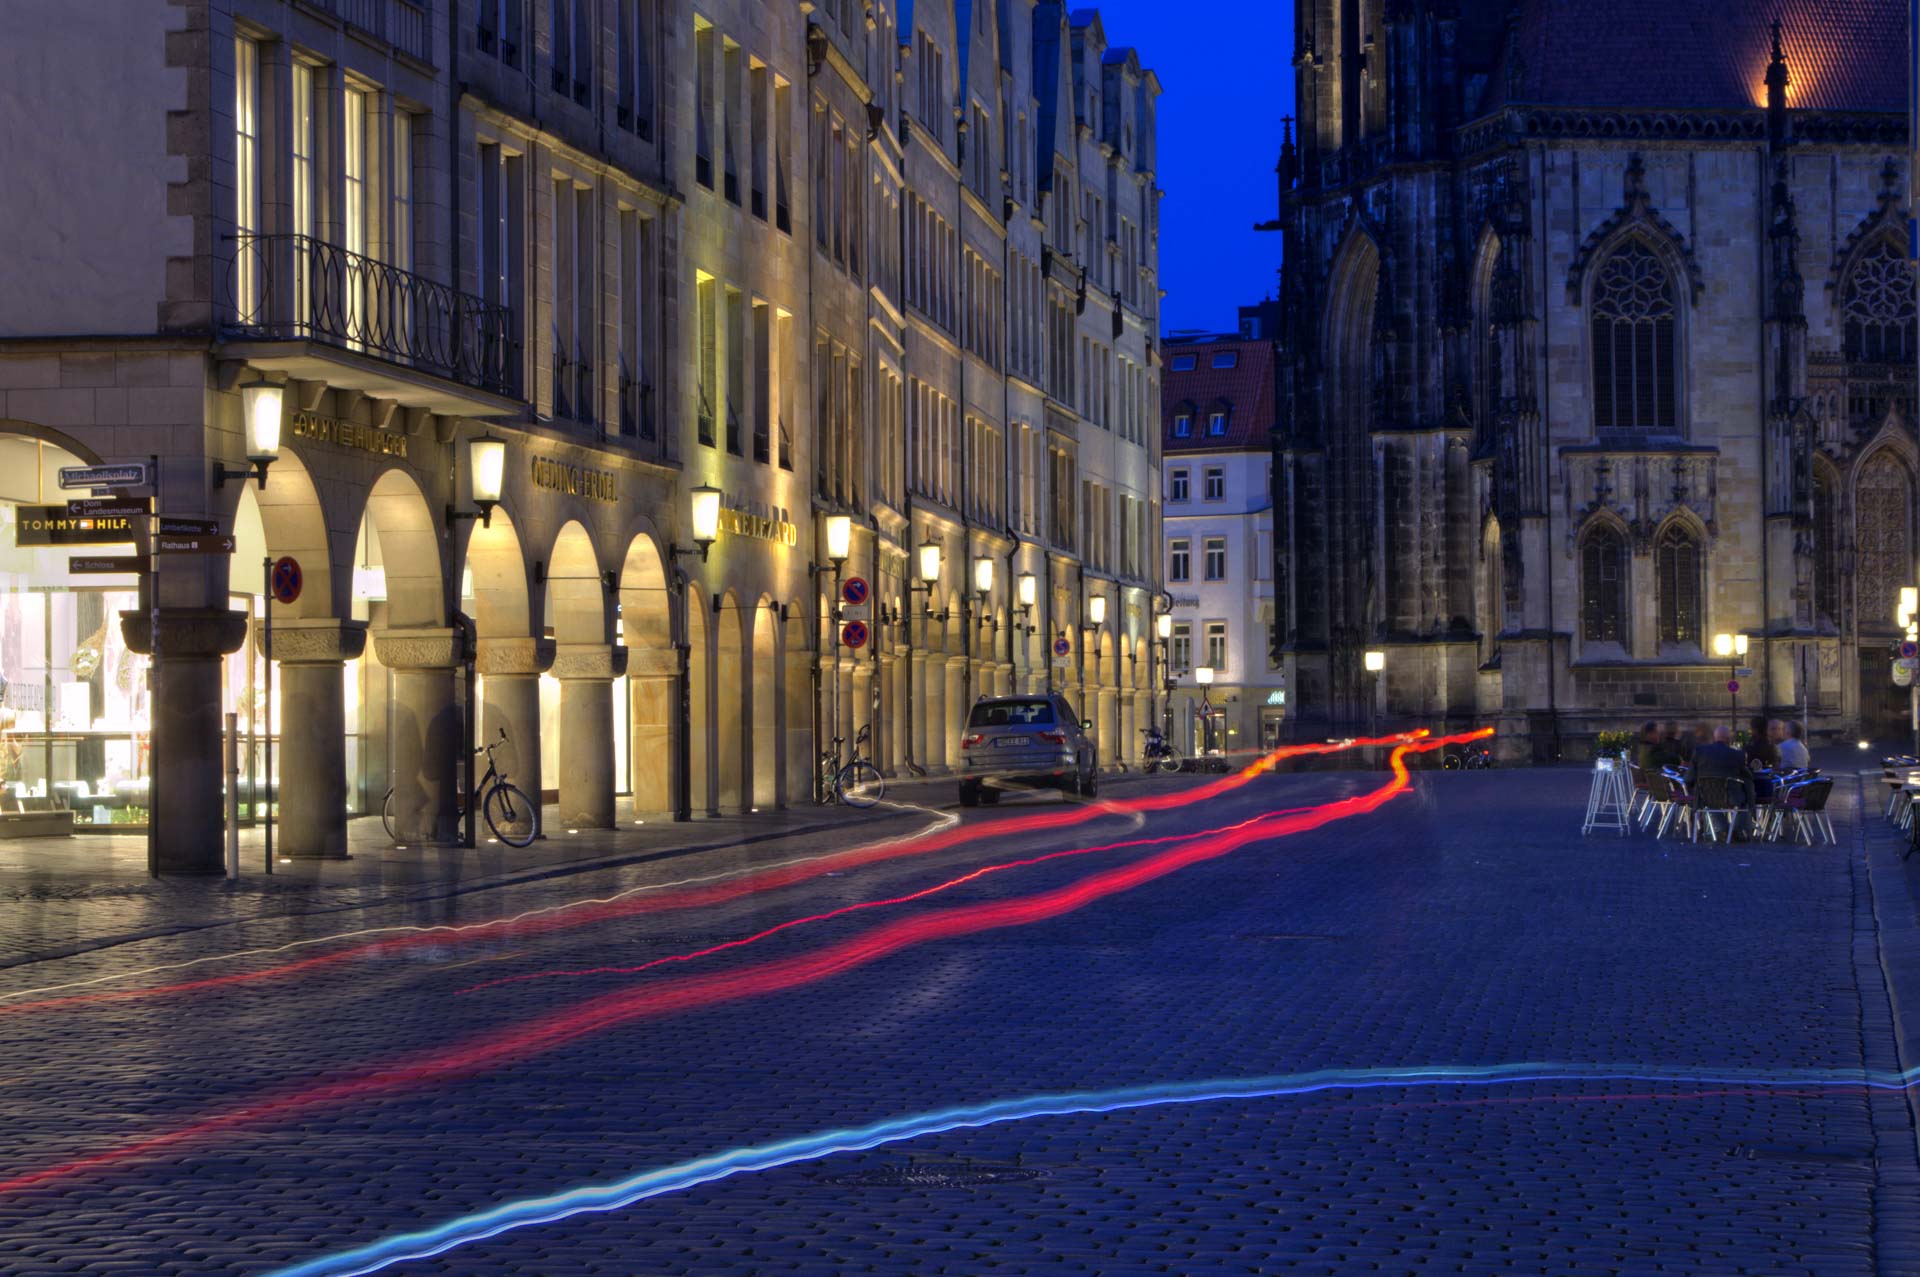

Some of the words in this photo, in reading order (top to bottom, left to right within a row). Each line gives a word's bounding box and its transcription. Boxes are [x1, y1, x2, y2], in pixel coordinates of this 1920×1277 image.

[354, 425, 407, 457] HILFIGER
[64, 469, 138, 482] Michaelisplatz
[83, 500, 102, 508] Dom
[83, 507, 143, 516] Landesmuseum
[22, 520, 77, 531] TOMMY
[97, 519, 132, 530] HILF
[161, 541, 190, 550] Rathaus
[84, 560, 115, 569] Schloss
